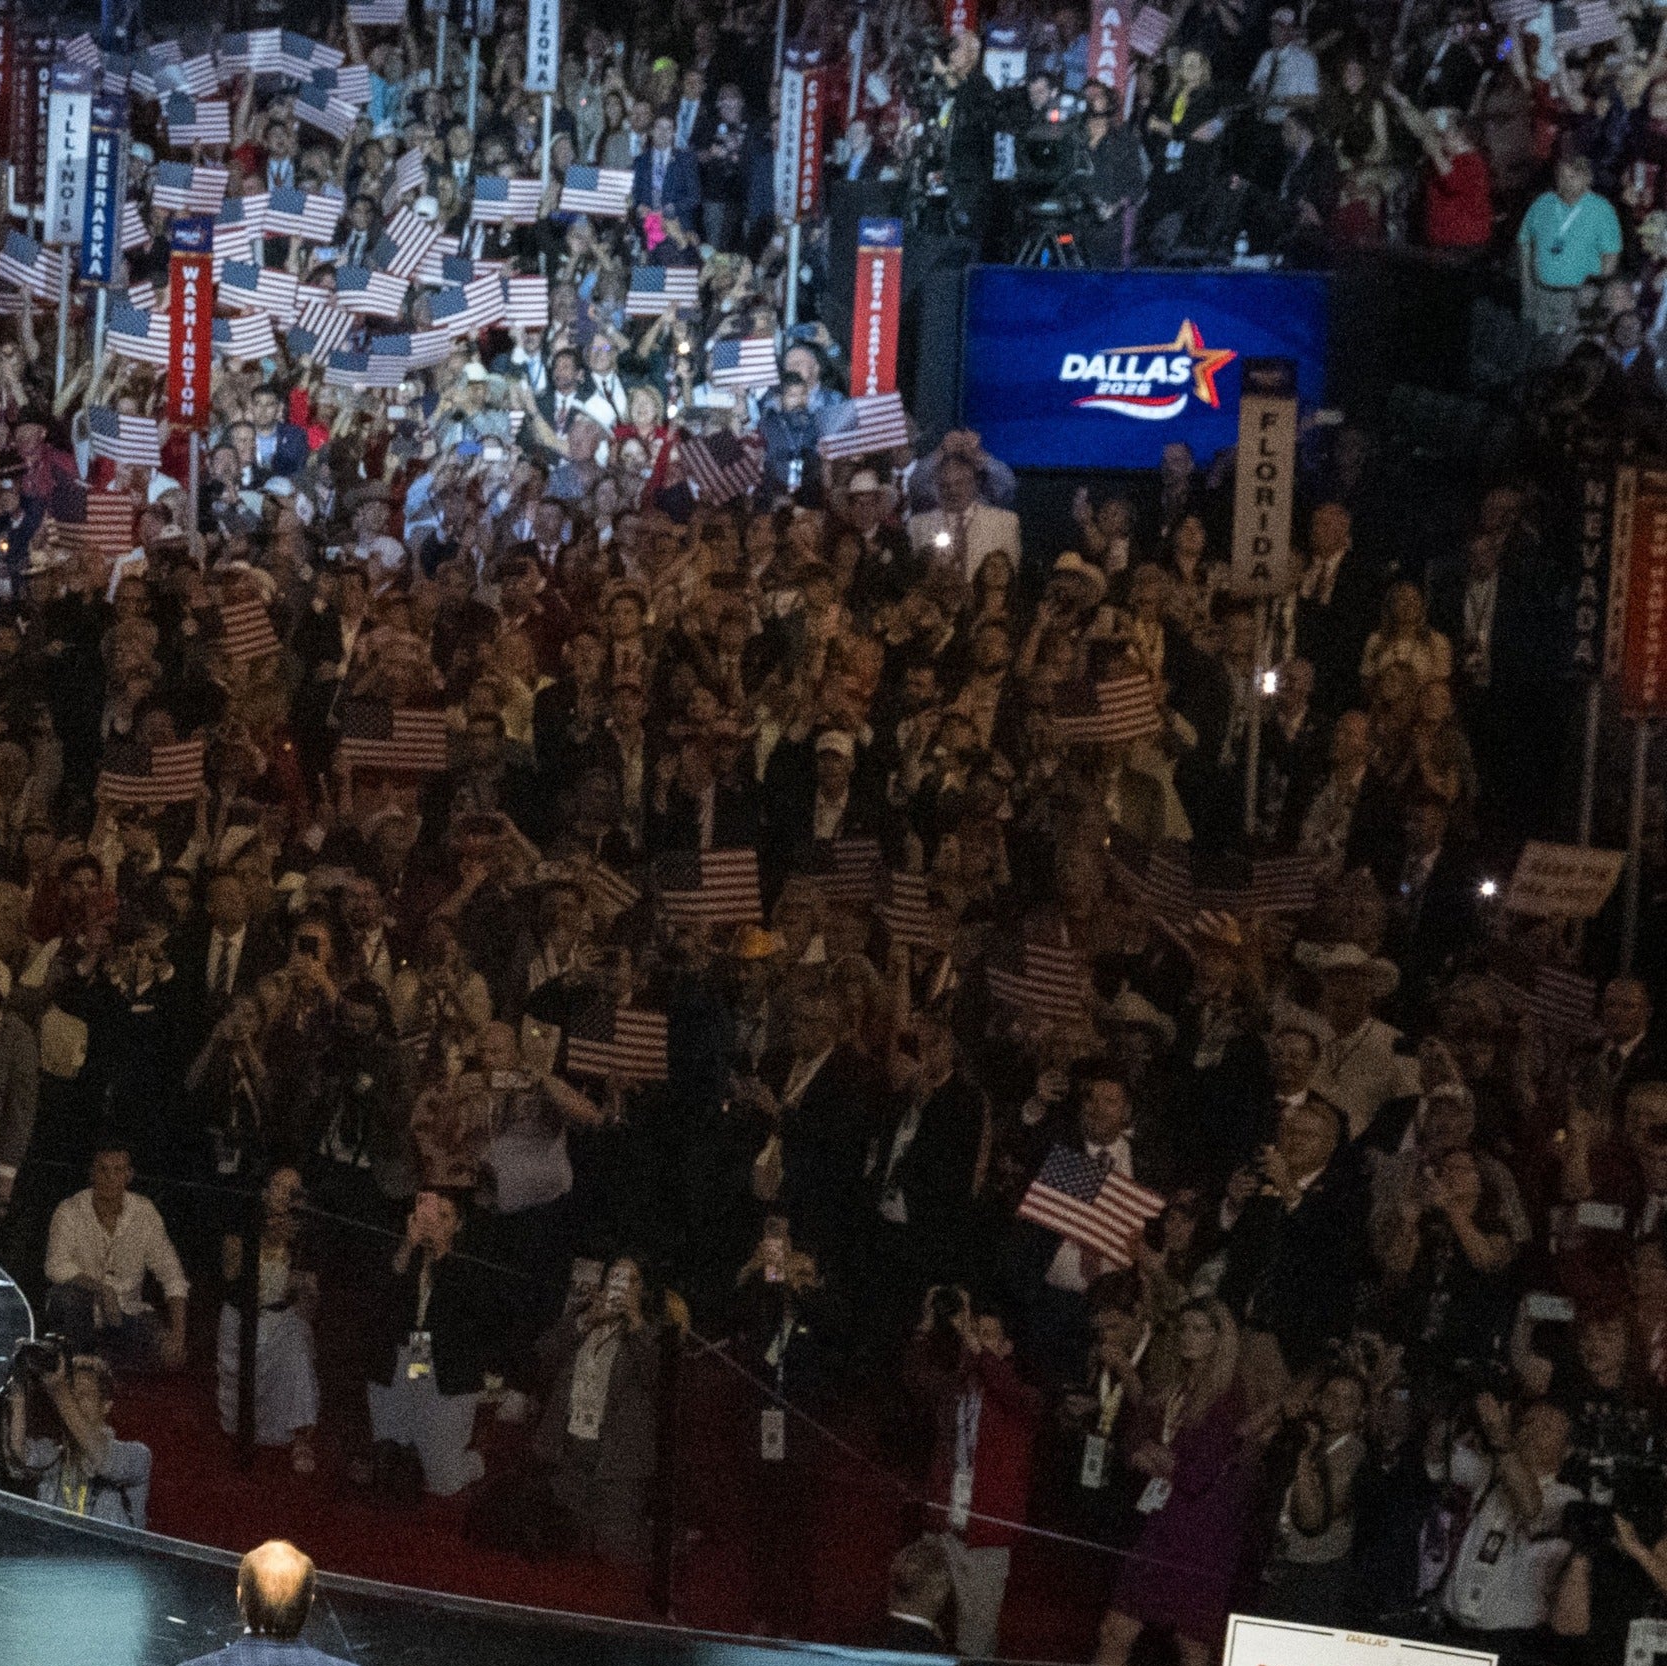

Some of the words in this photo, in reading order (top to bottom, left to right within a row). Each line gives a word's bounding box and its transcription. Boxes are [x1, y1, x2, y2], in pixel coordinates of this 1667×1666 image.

[61, 104, 77, 233] ILLINOIS
[88, 139, 110, 275] NEBRASKA
[801, 79, 818, 210] COLORADO
[182, 266, 199, 416] WASHINGTON
[1061, 352, 1192, 384] DALLAS
[1097, 383, 1151, 397] 2026
[1252, 412, 1278, 581] FLORIDA
[1575, 480, 1607, 663] NEVADA
[1345, 1634, 1389, 1648] DALLAS
